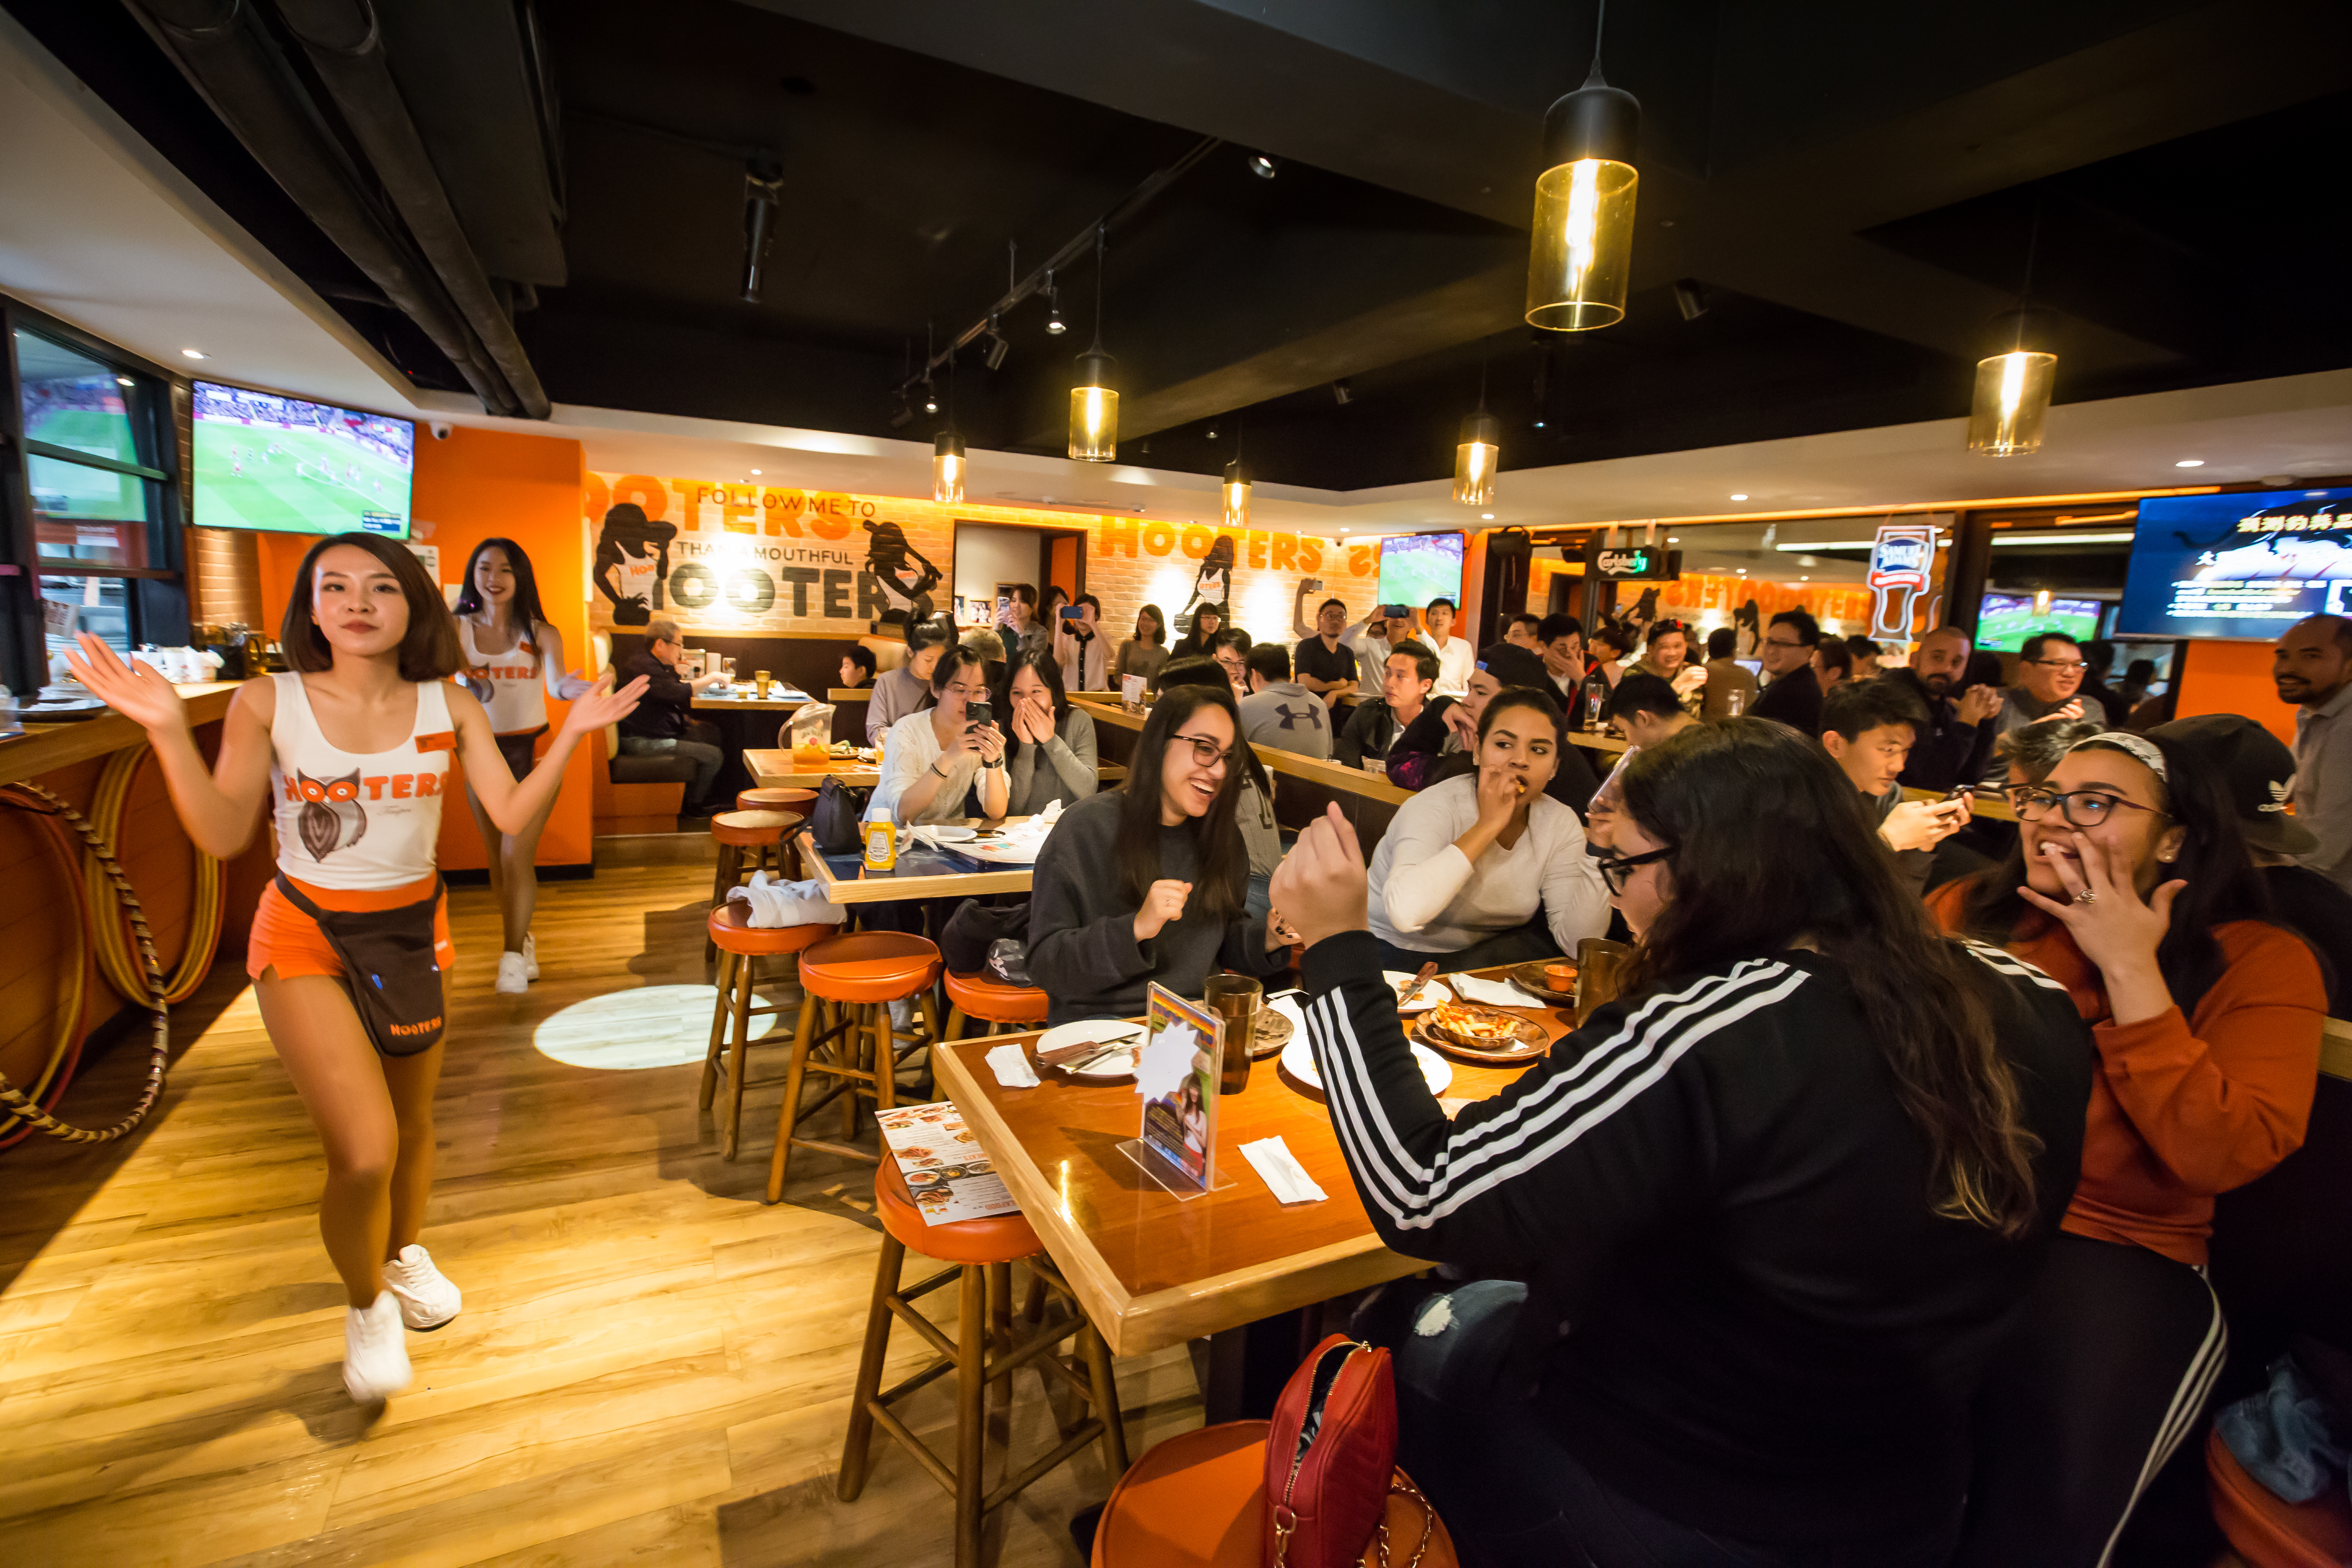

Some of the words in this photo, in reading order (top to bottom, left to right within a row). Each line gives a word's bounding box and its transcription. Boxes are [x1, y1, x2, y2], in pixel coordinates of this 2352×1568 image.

[698, 487, 802, 510] FOLLOW
[808, 497, 841, 514] ME
[848, 499, 875, 517] TO
[755, 546, 853, 565] MOUTHFUL
[630, 563, 657, 578] HOO
